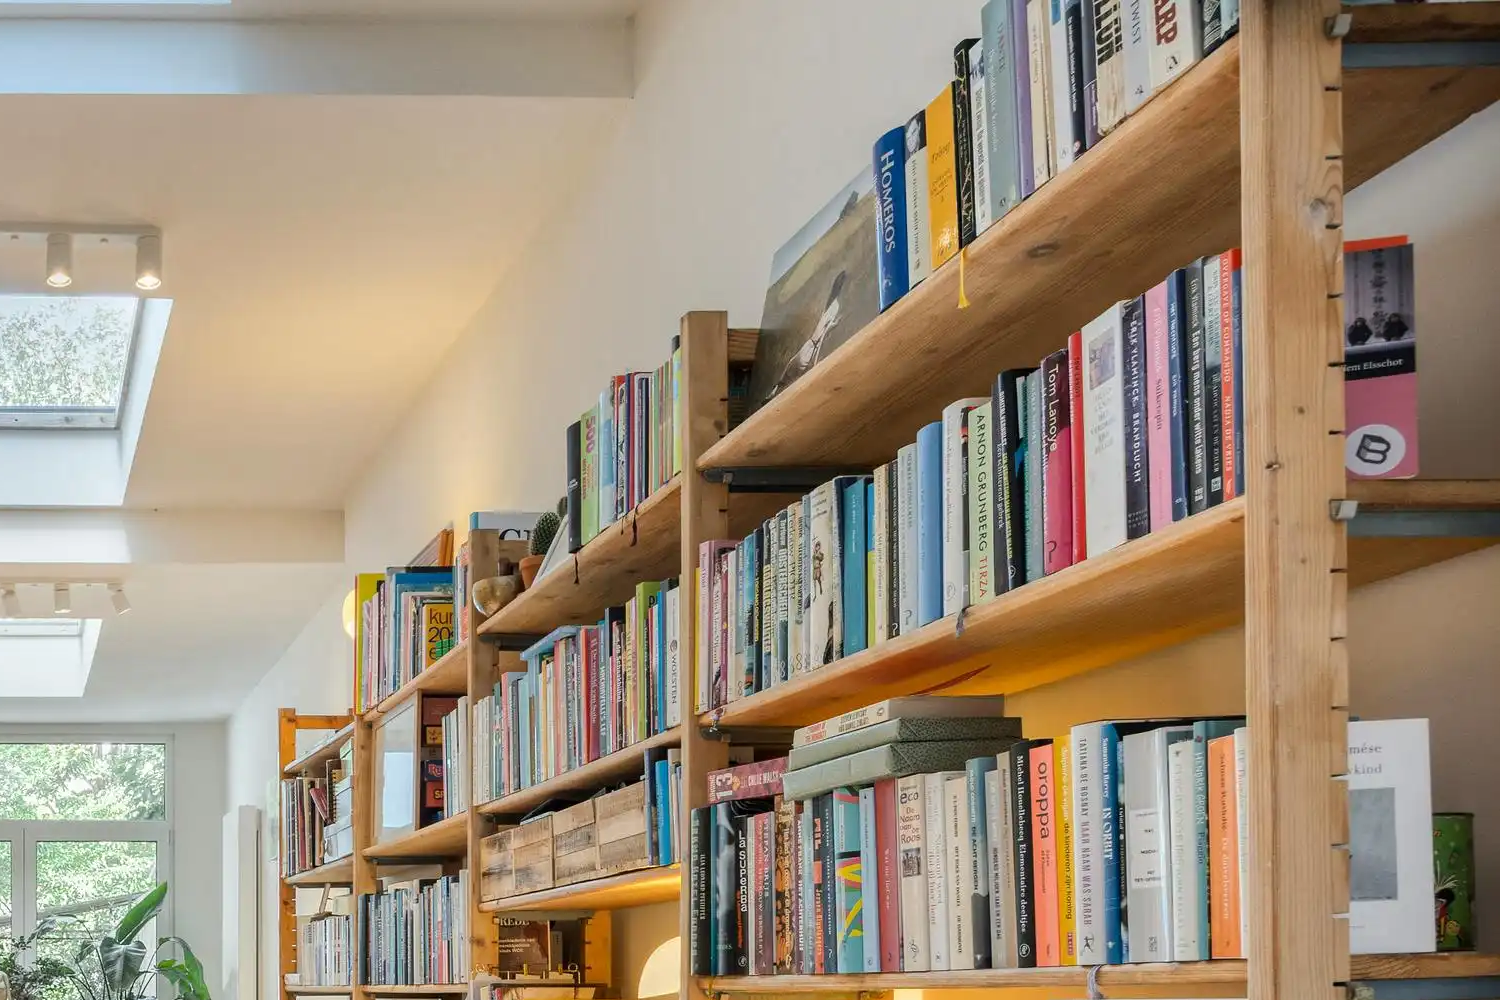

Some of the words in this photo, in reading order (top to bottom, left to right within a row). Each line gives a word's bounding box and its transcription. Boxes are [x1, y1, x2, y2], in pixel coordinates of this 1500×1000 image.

[880, 148, 896, 253] HOMEROS
[1222, 258, 1230, 307] OVERGAVE
[1130, 320, 1138, 346] ERIK
[1191, 329, 1201, 347] Een
[1190, 349, 1201, 371] berg
[1223, 326, 1231, 383] COMMANDO
[1362, 359, 1404, 371] Elsschot
[1048, 364, 1059, 397] Tom
[1131, 348, 1140, 403] VLAMINCK
[1192, 372, 1201, 395] mens
[1193, 397, 1202, 421] onder
[1224, 396, 1232, 425] NADIA
[977, 414, 987, 467] ARNON
[1046, 399, 1059, 452] Lanoye
[1194, 422, 1202, 444] witte
[1132, 411, 1141, 484] BRANDLUCHT
[1194, 444, 1203, 474] lakens
[1225, 444, 1233, 472] VRIES
[978, 471, 988, 552] GRUNBERG
[997, 503, 1005, 529] gebrek
[779, 547, 788, 622] OOSTERSCHELDE
[980, 555, 989, 598] TIRZA
[1016, 755, 1025, 785] Michel
[1079, 738, 1089, 771] TATIANA
[1102, 737, 1110, 773] Samantha
[1102, 774, 1110, 798] Harvey
[1195, 752, 1205, 792] HENDRIK
[899, 791, 919, 804] eco
[1036, 762, 1050, 840] oroppa
[1080, 785, 1091, 817] ROSNAY
[1103, 807, 1112, 819] IN
[1196, 794, 1205, 825] GROEN
[900, 815, 921, 823] Naam
[1017, 786, 1026, 841] Houellebecq
[900, 833, 921, 844] Roos
[1081, 821, 1091, 844] HAAR
[1103, 821, 1113, 860] ORBIT
[1197, 831, 1206, 865] Piaggio
[1064, 835, 1073, 873] kinderen
[1081, 847, 1091, 872] NAAM
[1019, 843, 1027, 898] Elementaire
[1082, 874, 1091, 894] WAS
[1222, 852, 1230, 919] duivelsverzen
[815, 889, 823, 912] Jeroen
[1019, 898, 1029, 933] deeltjes
[1064, 890, 1074, 920] koning
[1082, 897, 1092, 925] SARAH
